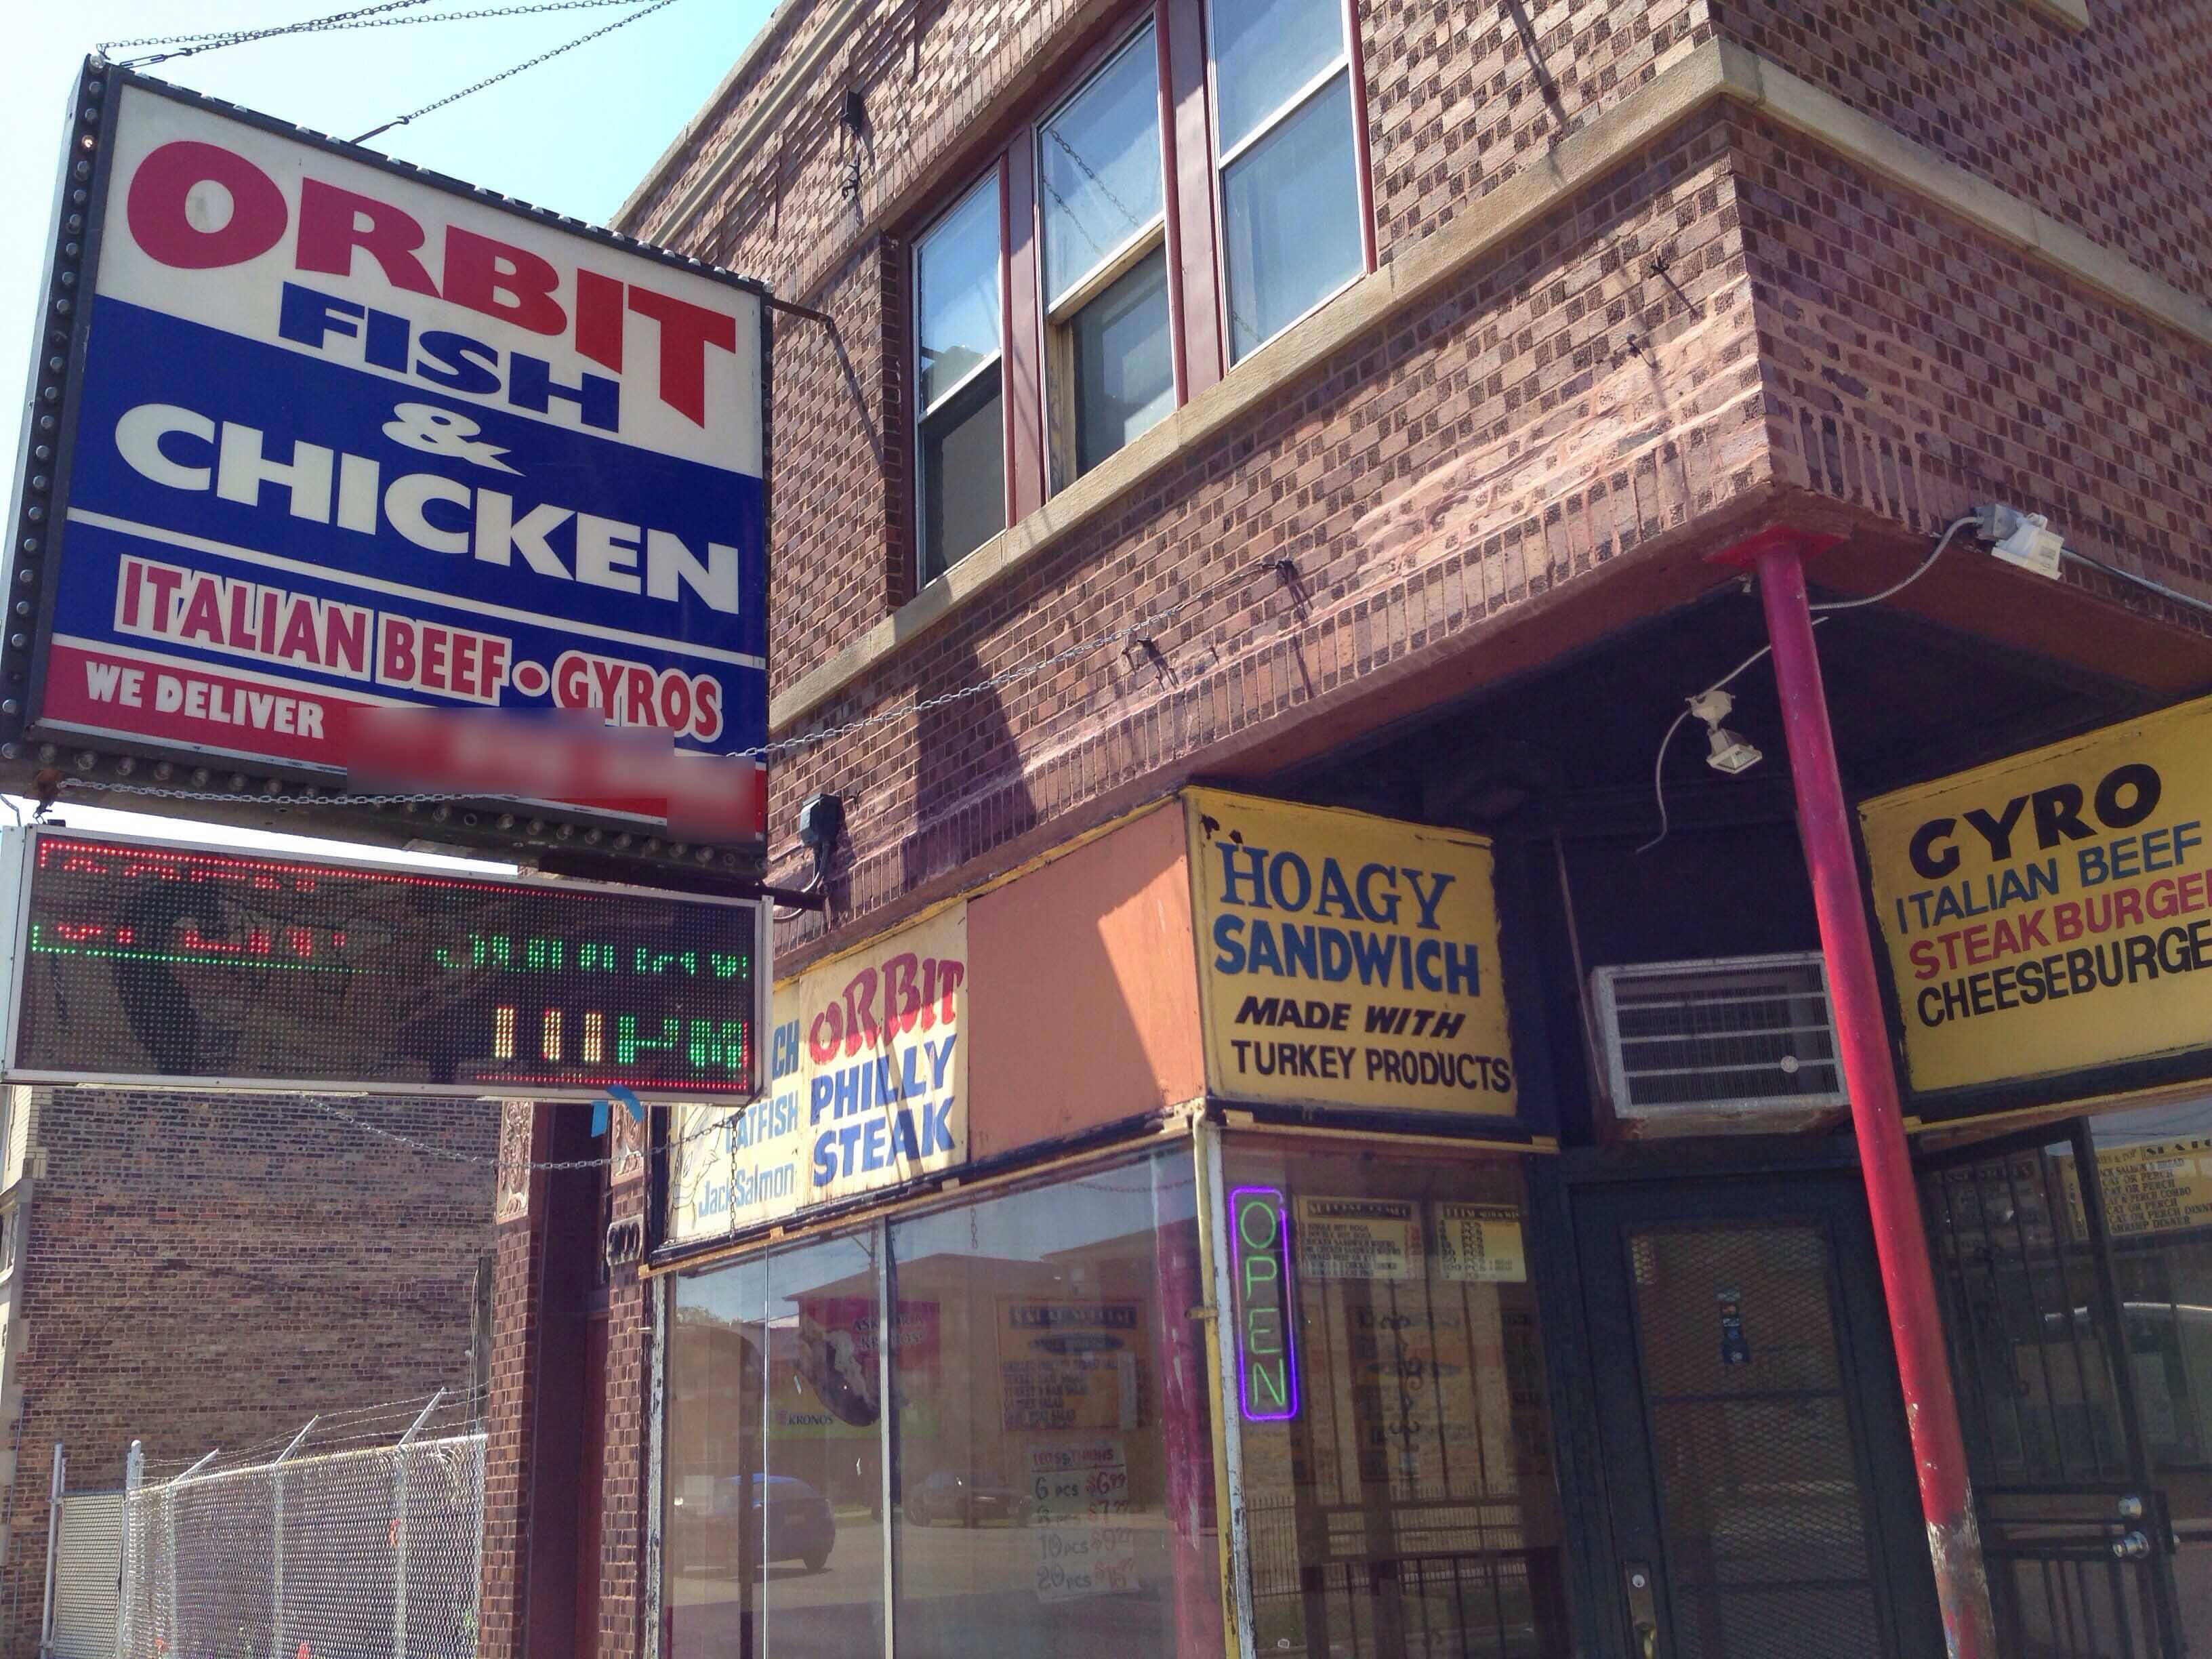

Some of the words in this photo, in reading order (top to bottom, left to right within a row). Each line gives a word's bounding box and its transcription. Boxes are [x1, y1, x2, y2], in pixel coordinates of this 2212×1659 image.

[127, 141, 737, 430] ORBIT
[279, 281, 620, 433] FISH
[382, 402, 526, 477] &
[115, 403, 740, 616] CHICKEN
[118, 557, 370, 677] ITALIAN
[380, 614, 510, 702] BEEF
[554, 652, 720, 738] GYROS
[86, 661, 142, 707] WE
[155, 673, 324, 739] DELIVER
[1909, 763, 2161, 880] GYRO
[1215, 841, 1455, 930] HOAGY
[1895, 857, 2060, 935] ITALIAN
[2077, 820, 2203, 888] BEEF
[1212, 914, 1480, 997] SANDWICH
[808, 952, 964, 1065] ORBIT
[1235, 996, 1351, 1031] MADE
[1364, 1004, 1466, 1039] WITH
[810, 1033, 958, 1127] PHILLY
[1231, 1040, 1355, 1079] TURKEY
[1366, 1047, 1511, 1093] PRODUCTS
[813, 1096, 956, 1187] STEAK
[736, 1163, 794, 1208] Salmon
[2111, 1221, 2149, 1233] SHRIMP
[2153, 1216, 2191, 1228] DINNER
[2143, 1180, 2175, 1191] PERCH
[2146, 1198, 2177, 1210] PERCH
[2148, 1208, 2181, 1219] PERCH
[1240, 1201, 1286, 1407] OPEN
[789, 1414, 833, 1426] KRONOS
[1035, 1477, 1049, 1500] 6
[1037, 1561, 1064, 1590] 20
